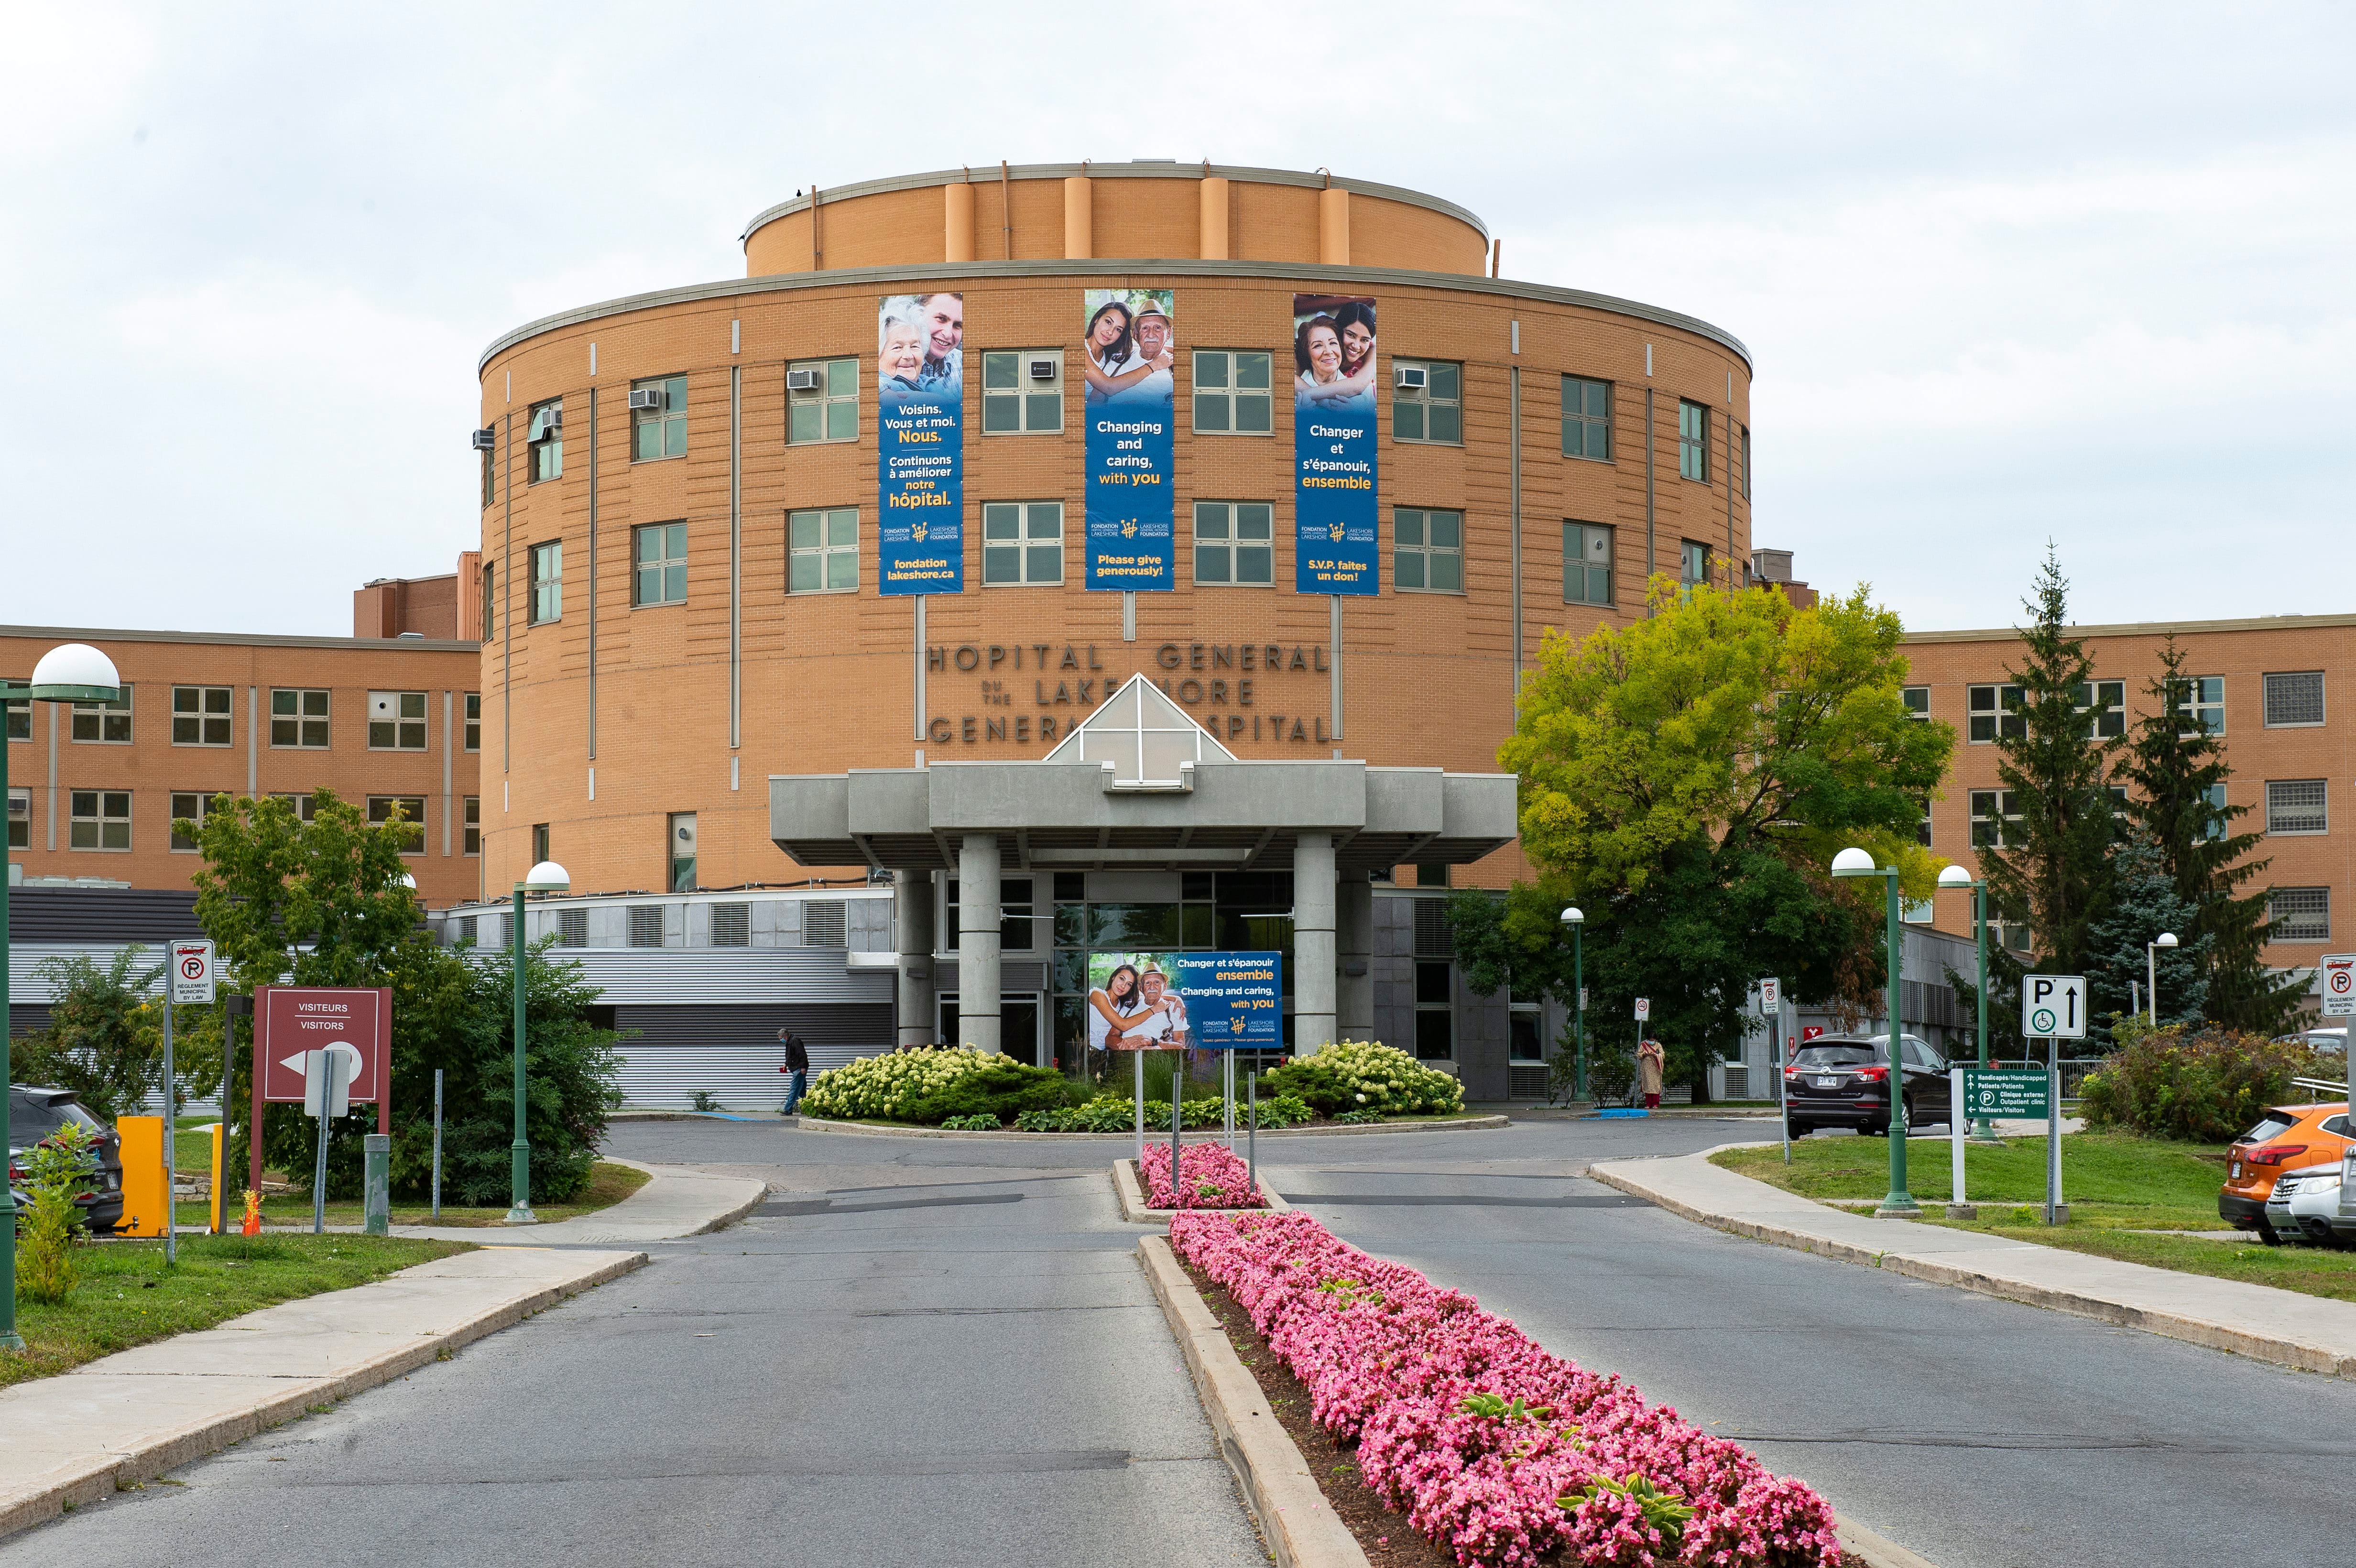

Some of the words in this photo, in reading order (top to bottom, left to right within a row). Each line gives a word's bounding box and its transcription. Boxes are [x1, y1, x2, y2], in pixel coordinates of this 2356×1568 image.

[899, 404, 942, 415] Voisins.
[885, 419, 913, 429] Vous
[916, 418, 927, 427] et
[931, 416, 956, 426] moi.
[1097, 421, 1162, 434] Changing
[899, 430, 942, 443] Nous.
[1310, 425, 1363, 439] Changer
[1117, 438, 1142, 449] and
[1331, 444, 1343, 454] et
[889, 456, 951, 467] Continuons
[1107, 455, 1152, 468] caring,
[1303, 458, 1370, 474] s’épanouir,
[889, 468, 896, 479] à
[899, 467, 951, 478] améliorer
[906, 480, 935, 490] notre
[1099, 473, 1127, 484] with
[1132, 474, 1160, 486] you
[1302, 476, 1371, 489] ensemble
[890, 491, 951, 509] hôpital.
[894, 559, 947, 569] fondation
[1098, 555, 1134, 564] Please
[1137, 555, 1161, 566] give
[1309, 560, 1335, 569] S.V.P.
[1338, 561, 1367, 570] faites
[888, 570, 954, 580] lakeshore.ca
[1097, 566, 1163, 577] generously!
[927, 644, 1102, 670] HOPITAL
[1156, 643, 1329, 670] GENERAL
[982, 680, 1001, 692] DU
[1036, 678, 1254, 705] LAKEHORE
[982, 694, 1010, 704] THE
[929, 716, 1077, 741] GENERA
[1208, 715, 1330, 741] SPITAL
[1178, 959, 1215, 969] Changer
[1228, 958, 1274, 968] s’épanouir
[1216, 969, 1274, 980] ensemble
[1181, 987, 1223, 996] Changing
[1225, 987, 1242, 995] and
[1244, 986, 1274, 996] caring,
[2035, 980, 2053, 1004] P
[299, 1003, 348, 1012] VISITEURS
[1231, 1000, 1250, 1008] with
[1252, 1000, 1274, 1010] you
[301, 1022, 344, 1030] VISITORS
